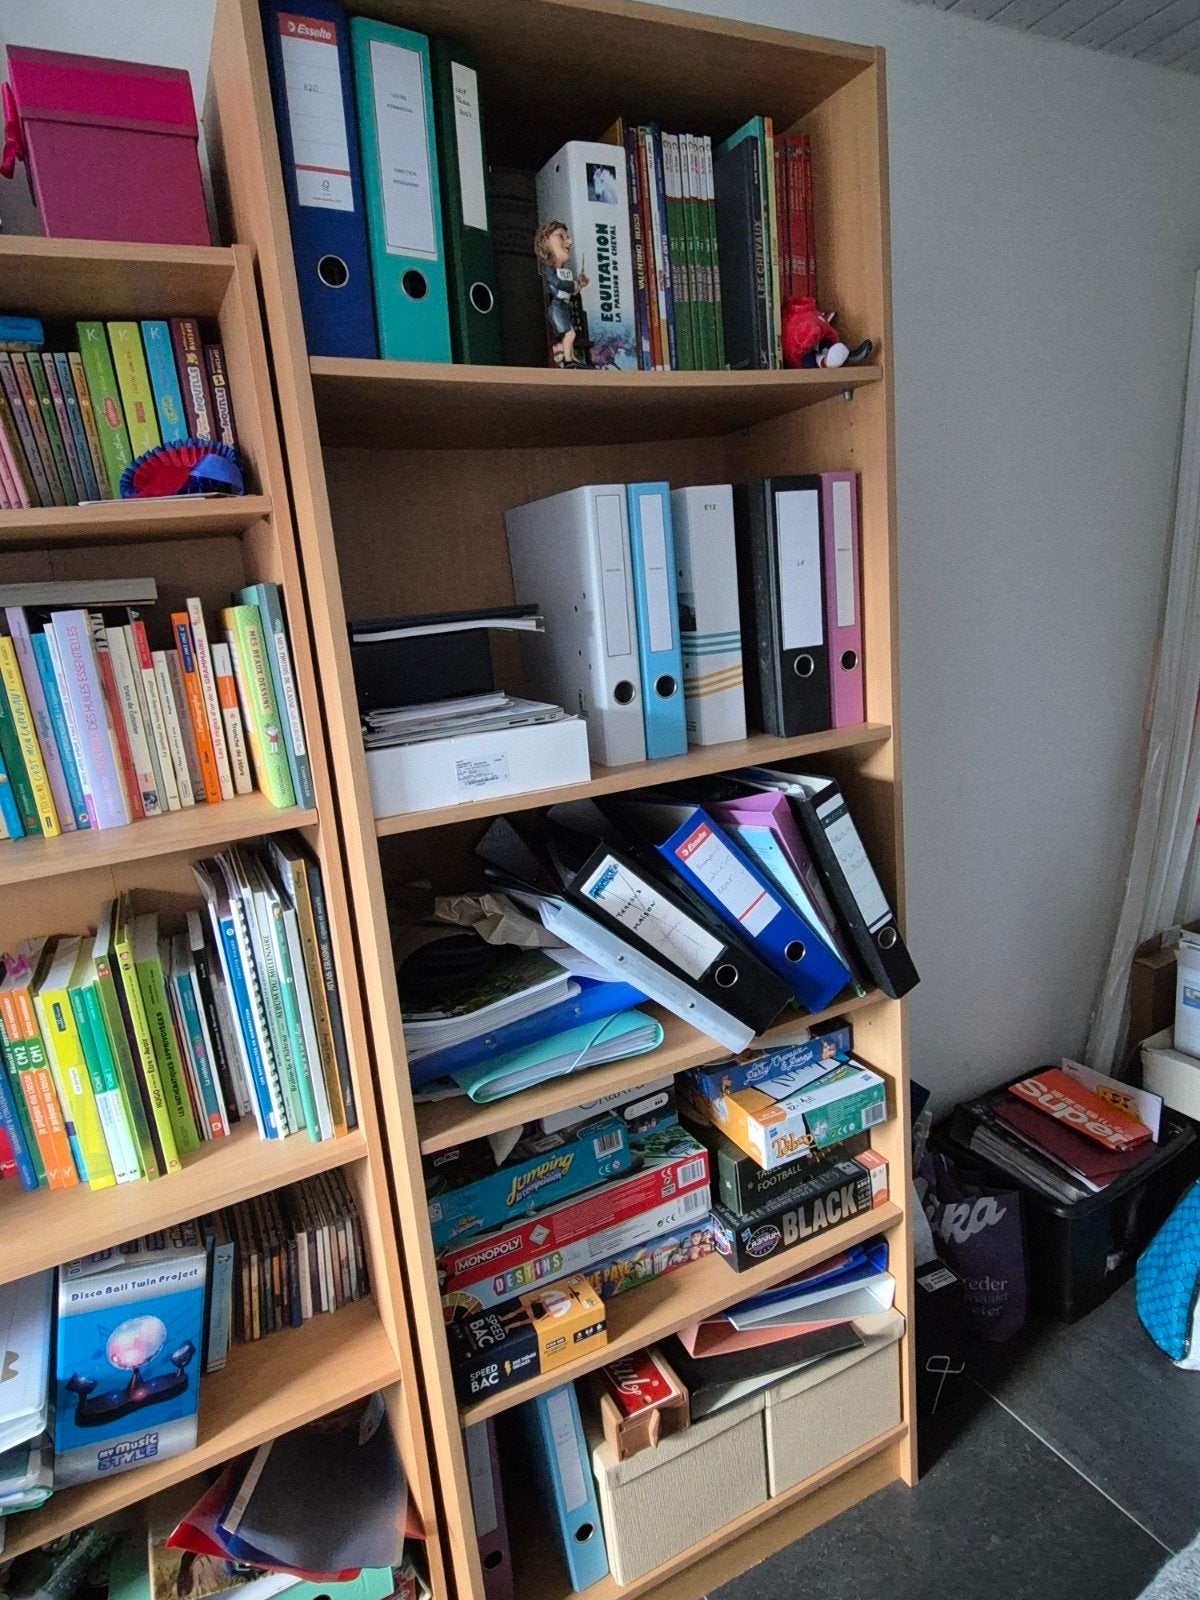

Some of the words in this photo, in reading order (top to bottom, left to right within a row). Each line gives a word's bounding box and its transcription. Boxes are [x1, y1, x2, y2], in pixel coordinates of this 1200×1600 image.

[297, 25, 332, 40] Esselte
[632, 213, 641, 239] ROSSI
[609, 225, 617, 255] CHEVAL
[753, 220, 764, 273] CHEVAUX
[596, 223, 614, 322] EQUITATION
[611, 260, 617, 270] DU
[634, 244, 646, 289] VALENTINO
[612, 274, 620, 308] PASSION
[614, 312, 621, 322] LA
[188, 366, 205, 412] NOUILLE
[215, 387, 230, 426] NOUILLE
[704, 503, 717, 511] E12
[247, 629, 258, 647] MES
[276, 636, 284, 651] MES
[66, 624, 88, 682] ESSENTIELLES
[196, 637, 211, 684] GRAMMAIRE
[251, 648, 264, 675] BEAUX
[278, 651, 289, 675] PHOTOS
[79, 682, 94, 712] HUILES
[122, 684, 132, 701] trucs
[205, 684, 212, 692] la
[206, 693, 214, 702] de
[256, 676, 271, 710] DESSINS
[11, 692, 30, 736] CERVEAU
[126, 701, 134, 709] de
[208, 702, 216, 716] d'or
[85, 712, 98, 731] DES
[128, 709, 141, 735] cuisinier
[210, 716, 221, 737] règles
[214, 737, 222, 747] 50
[230, 722, 240, 748] Tronche
[216, 747, 224, 759] Les
[235, 748, 242, 757] de
[236, 758, 246, 776] zèbre
[687, 830, 707, 853] Esselte
[633, 900, 656, 931] MAISON
[320, 943, 331, 970] ERASME
[270, 979, 278, 991] DU
[324, 970, 334, 991] ATLAS
[272, 992, 283, 1018] ALBUM
[14, 1045, 28, 1065] CM2
[29, 1043, 43, 1063] CM1
[140, 1037, 151, 1055] Avoir
[22, 1073, 34, 1094] classe
[37, 1071, 49, 1092] classe
[152, 1088, 163, 1108] HUGO
[1014, 1078, 1133, 1144] Super
[772, 1132, 814, 1159] Taboo
[506, 1152, 575, 1208] Jumping
[757, 1164, 802, 1192] FOOTBALL
[782, 1182, 860, 1246] BLACK
[457, 1238, 521, 1271] MONOPOLY
[71, 1288, 102, 1302] Disco
[105, 1281, 128, 1295] Ball
[131, 1276, 156, 1290] Twin
[159, 1267, 199, 1285] Project
[495, 1252, 563, 1294] DESTINS
[469, 1319, 494, 1348] BAC
[485, 1314, 506, 1341] SPEED
[470, 1363, 498, 1382] SPEED
[471, 1373, 499, 1393] BAC
[114, 1432, 159, 1456] Music
[98, 1445, 159, 1472] STYLE
